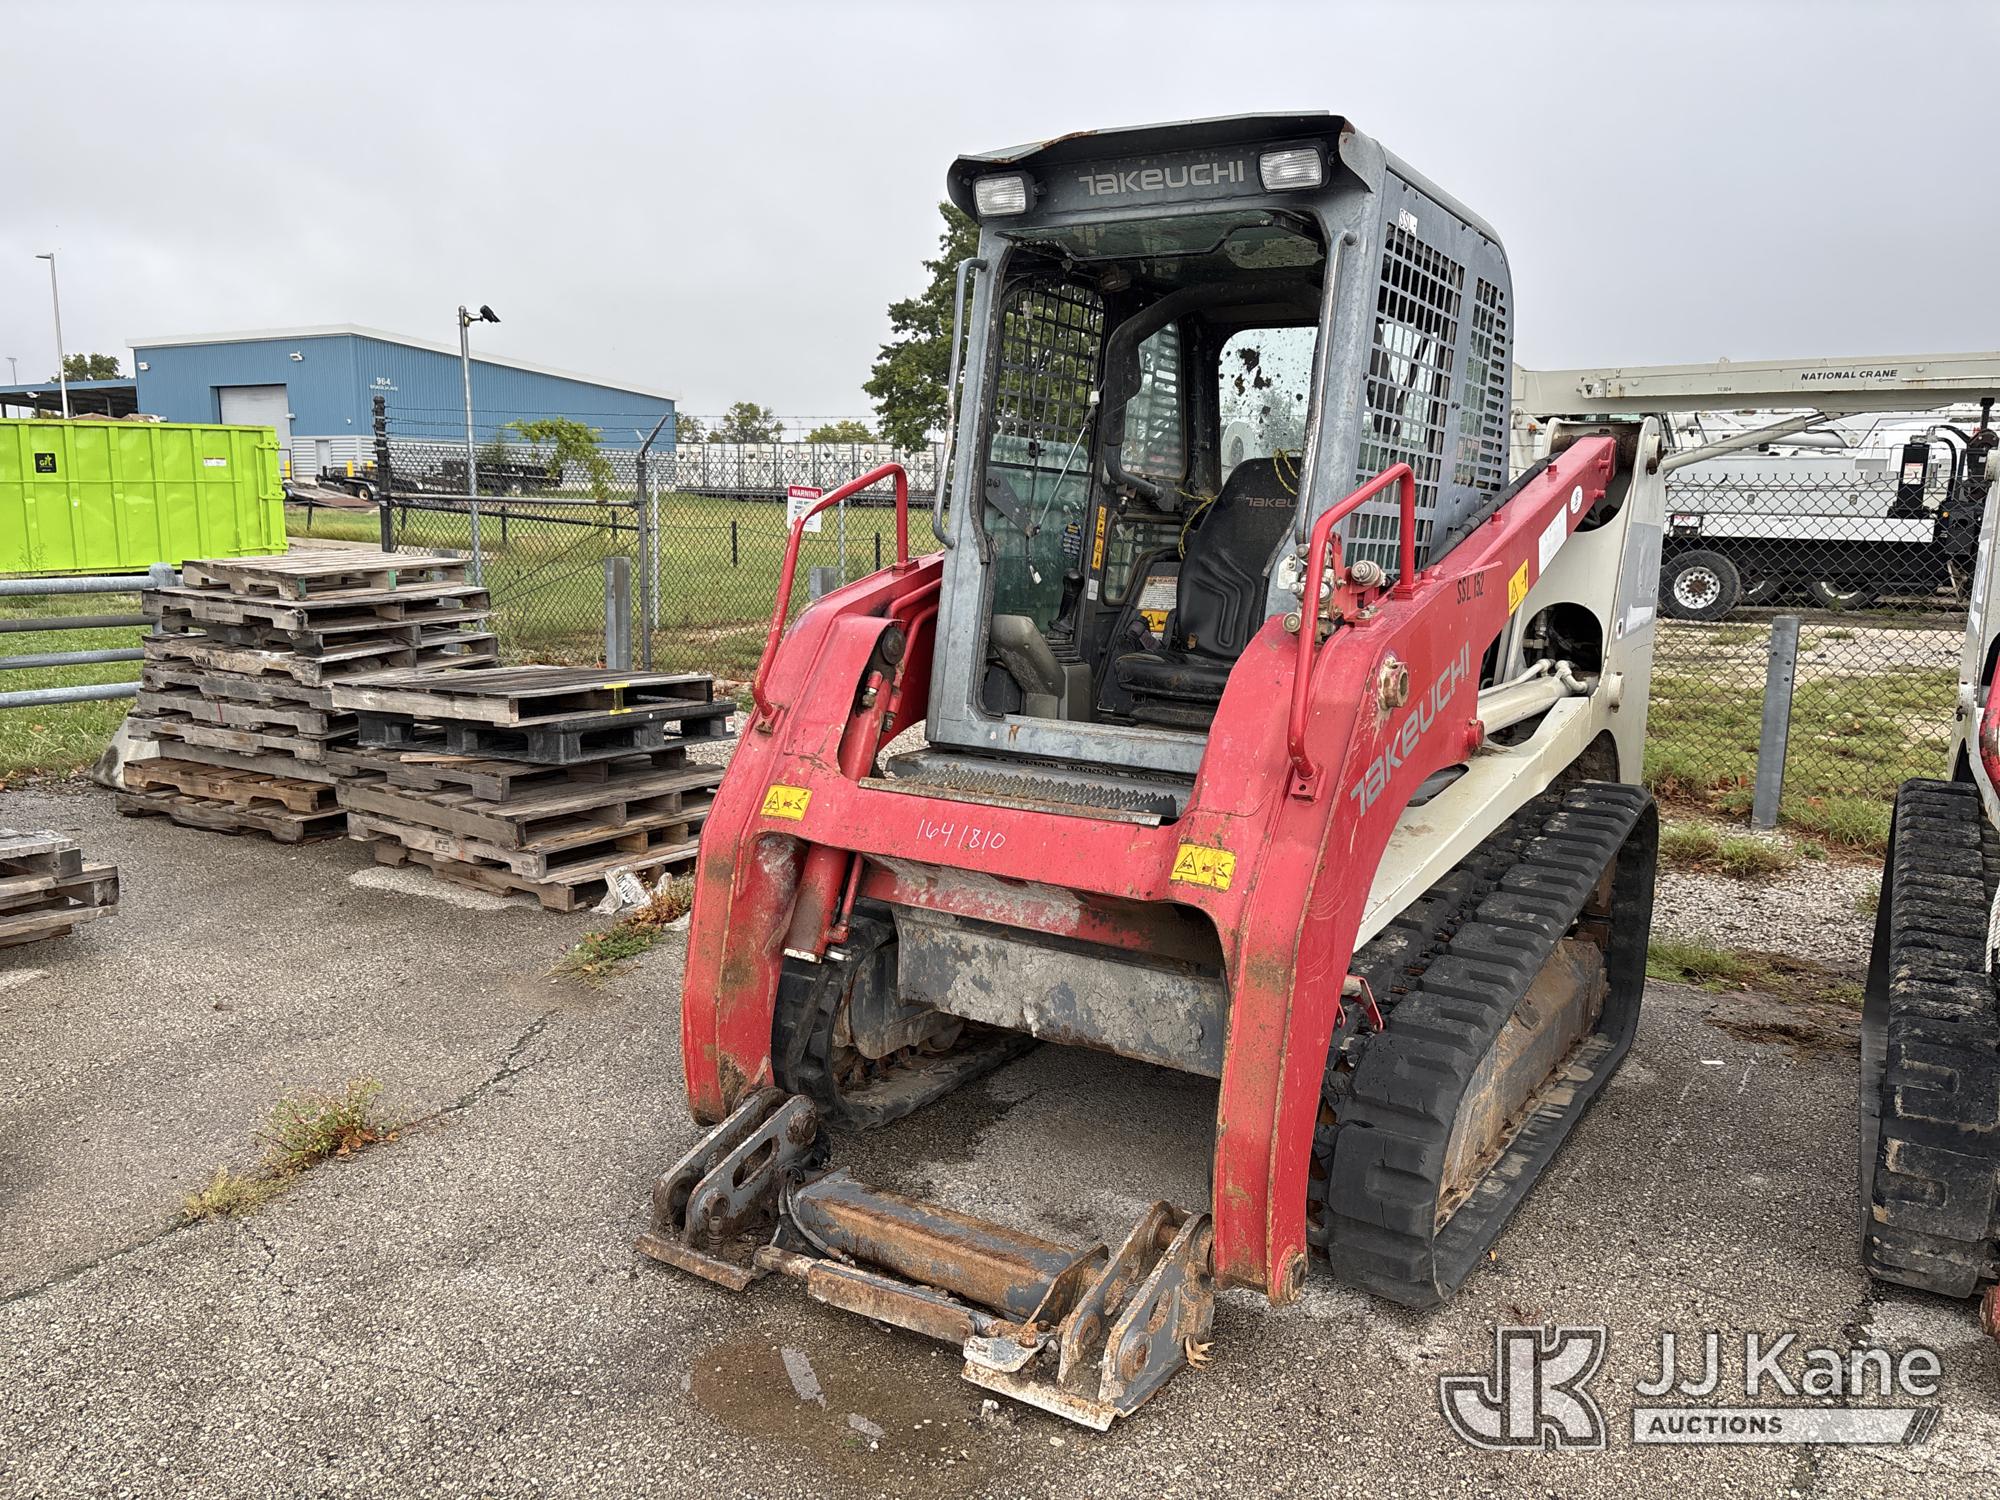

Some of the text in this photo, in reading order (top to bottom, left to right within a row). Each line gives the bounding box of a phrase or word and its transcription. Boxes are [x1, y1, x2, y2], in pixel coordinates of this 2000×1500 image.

[1078, 160, 1245, 197] TAKEUCHI
[1800, 369, 1898, 381] NATIONAL CRANE
[791, 488, 819, 498] WARNING
[1246, 497, 1298, 508] TAKEU
[1350, 639, 1471, 817] TAKEUCHI
